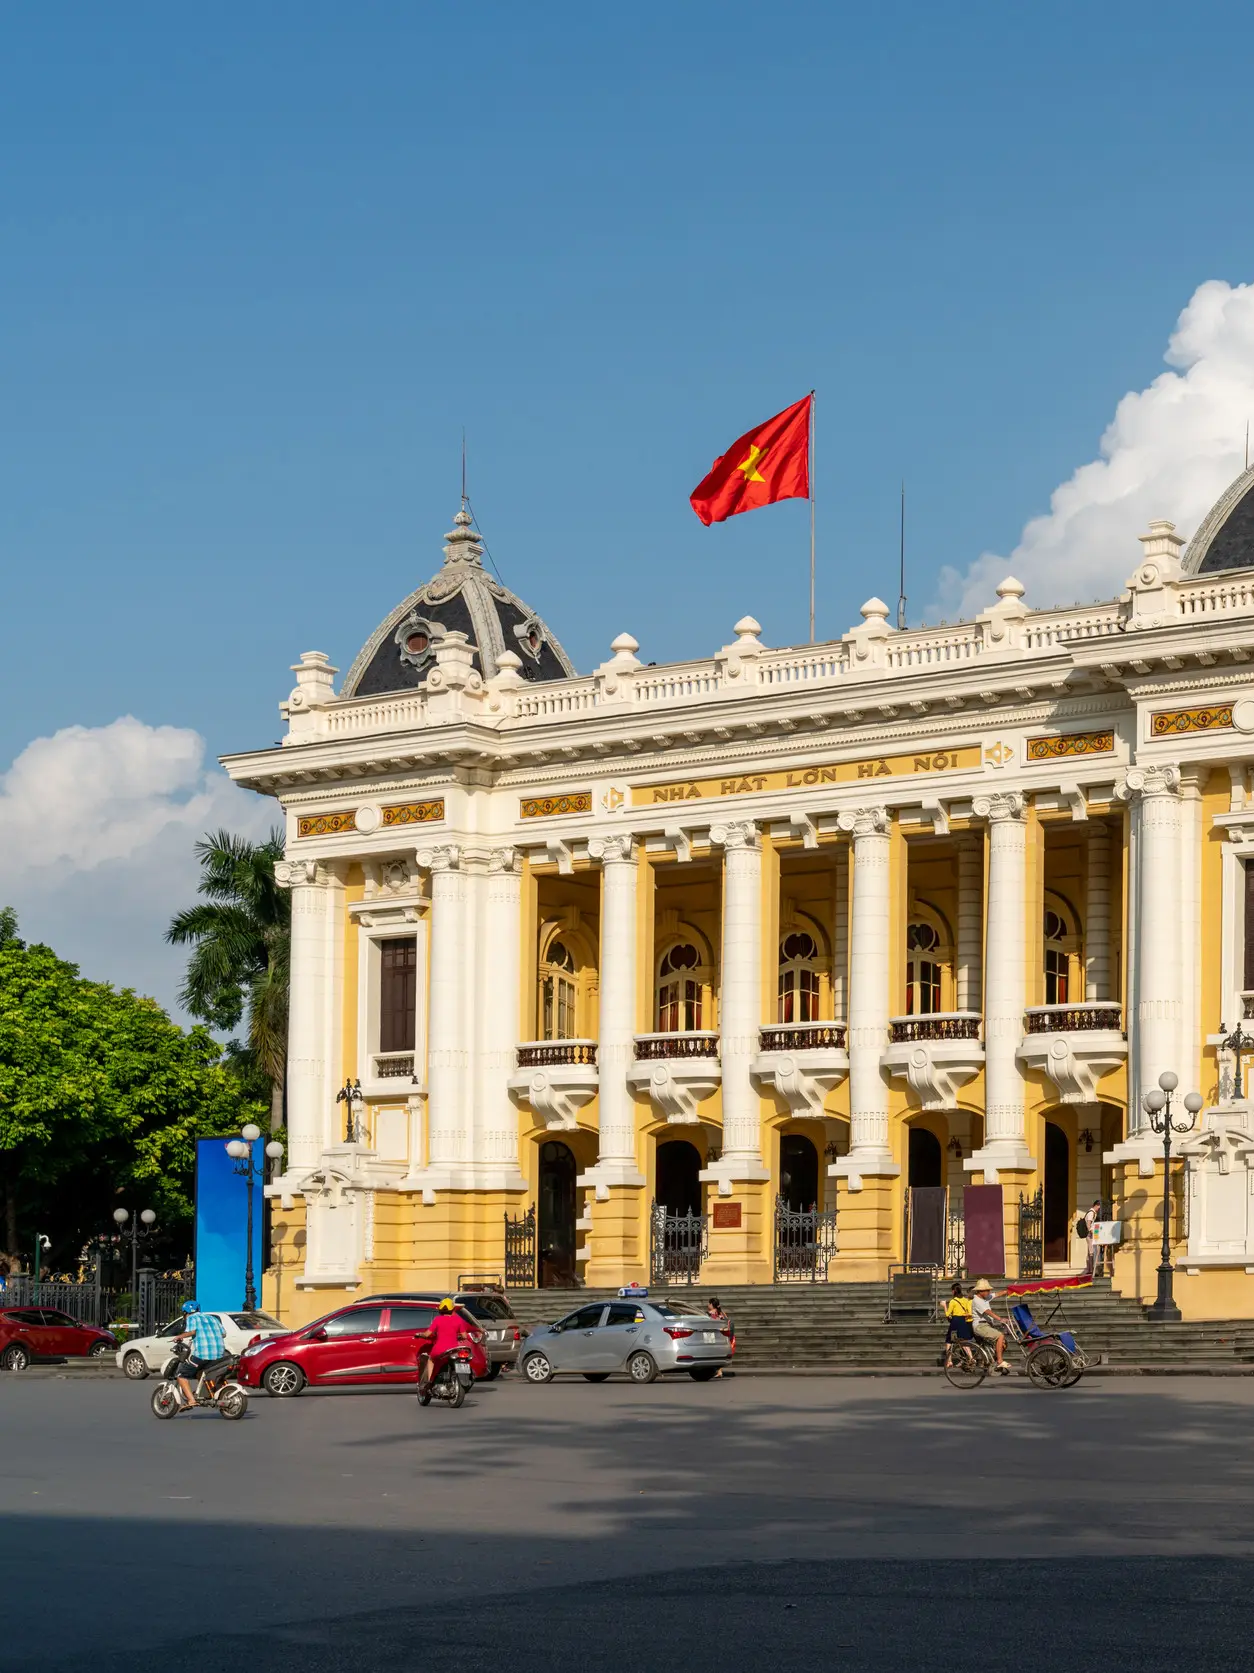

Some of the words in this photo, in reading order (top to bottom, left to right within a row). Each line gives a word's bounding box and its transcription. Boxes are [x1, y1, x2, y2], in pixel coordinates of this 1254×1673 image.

[653, 781, 702, 803] NHÀ
[720, 775, 768, 795] HÁT
[786, 767, 837, 787] LỚN
[857, 758, 892, 778] HÀ
[913, 752, 958, 772] NỘI
